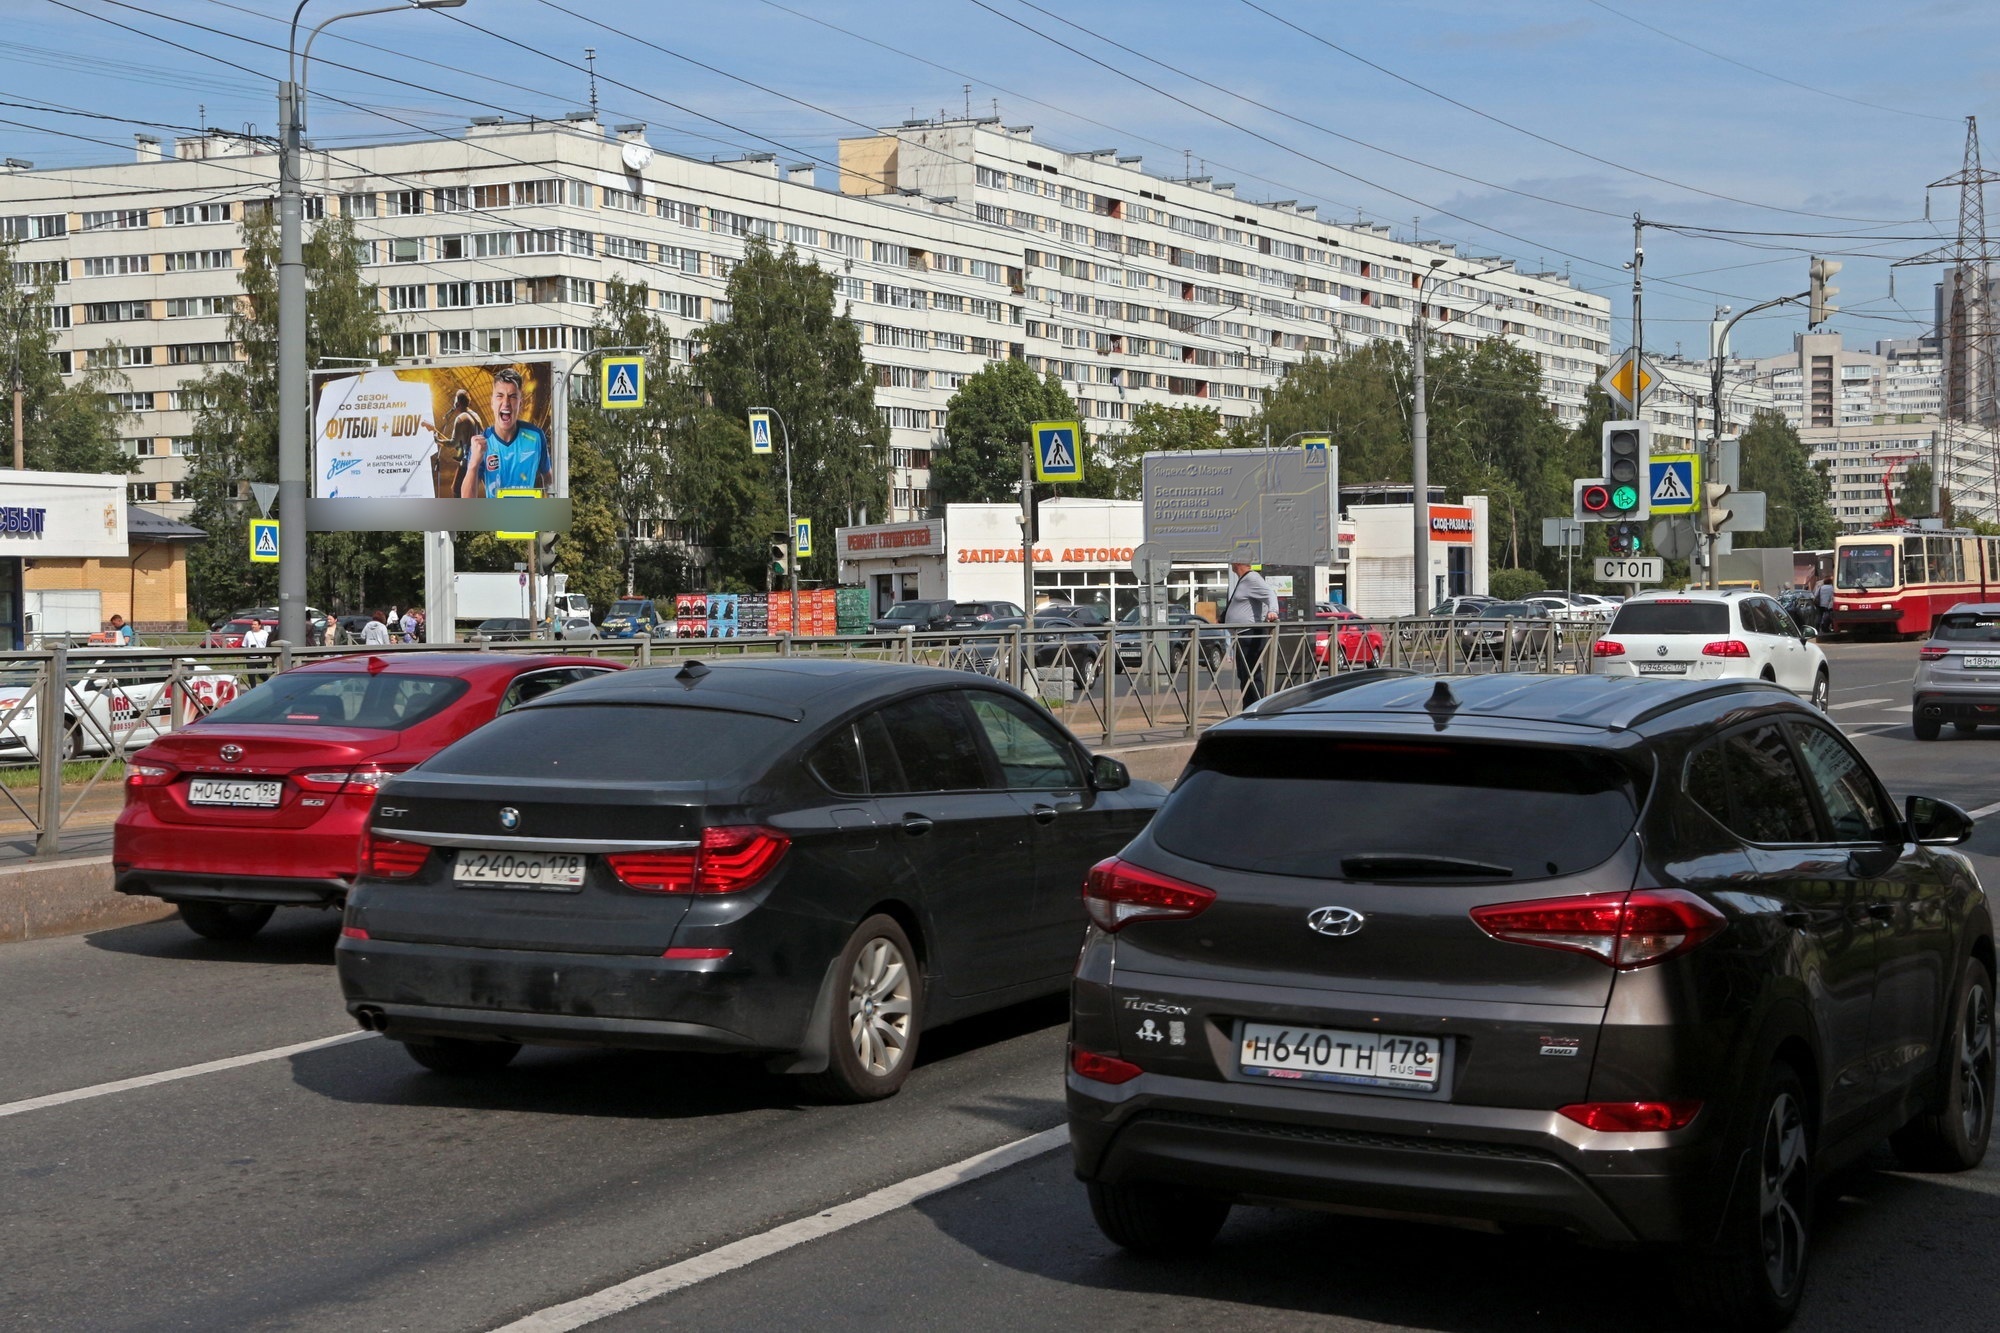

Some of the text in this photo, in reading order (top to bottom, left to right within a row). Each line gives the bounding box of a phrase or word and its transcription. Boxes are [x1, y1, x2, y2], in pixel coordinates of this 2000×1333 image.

[357, 394, 389, 402] СЕЗОН
[354, 401, 407, 410] ЗВЁЗДАМИ
[325, 414, 421, 439] ФУТБОЛ + ШОУ
[1154, 465, 1233, 477] Яндекс Маркет
[1154, 485, 1223, 498] Бесплатная
[1154, 498, 1209, 510] доставка
[1154, 510, 1161, 519] в
[1164, 508, 1198, 521] пункт
[847, 525, 931, 551] РЕМОНТ ГЛУШИТЕЛЕЙ
[1604, 562, 1652, 578] СТОП
[193, 781, 277, 800] М046АС 198
[380, 806, 409, 817] GT
[462, 854, 579, 879] Х240ОО 178
[1253, 1031, 1429, 1070] Н640ТН 178
[1390, 1064, 1414, 1075] RUS
